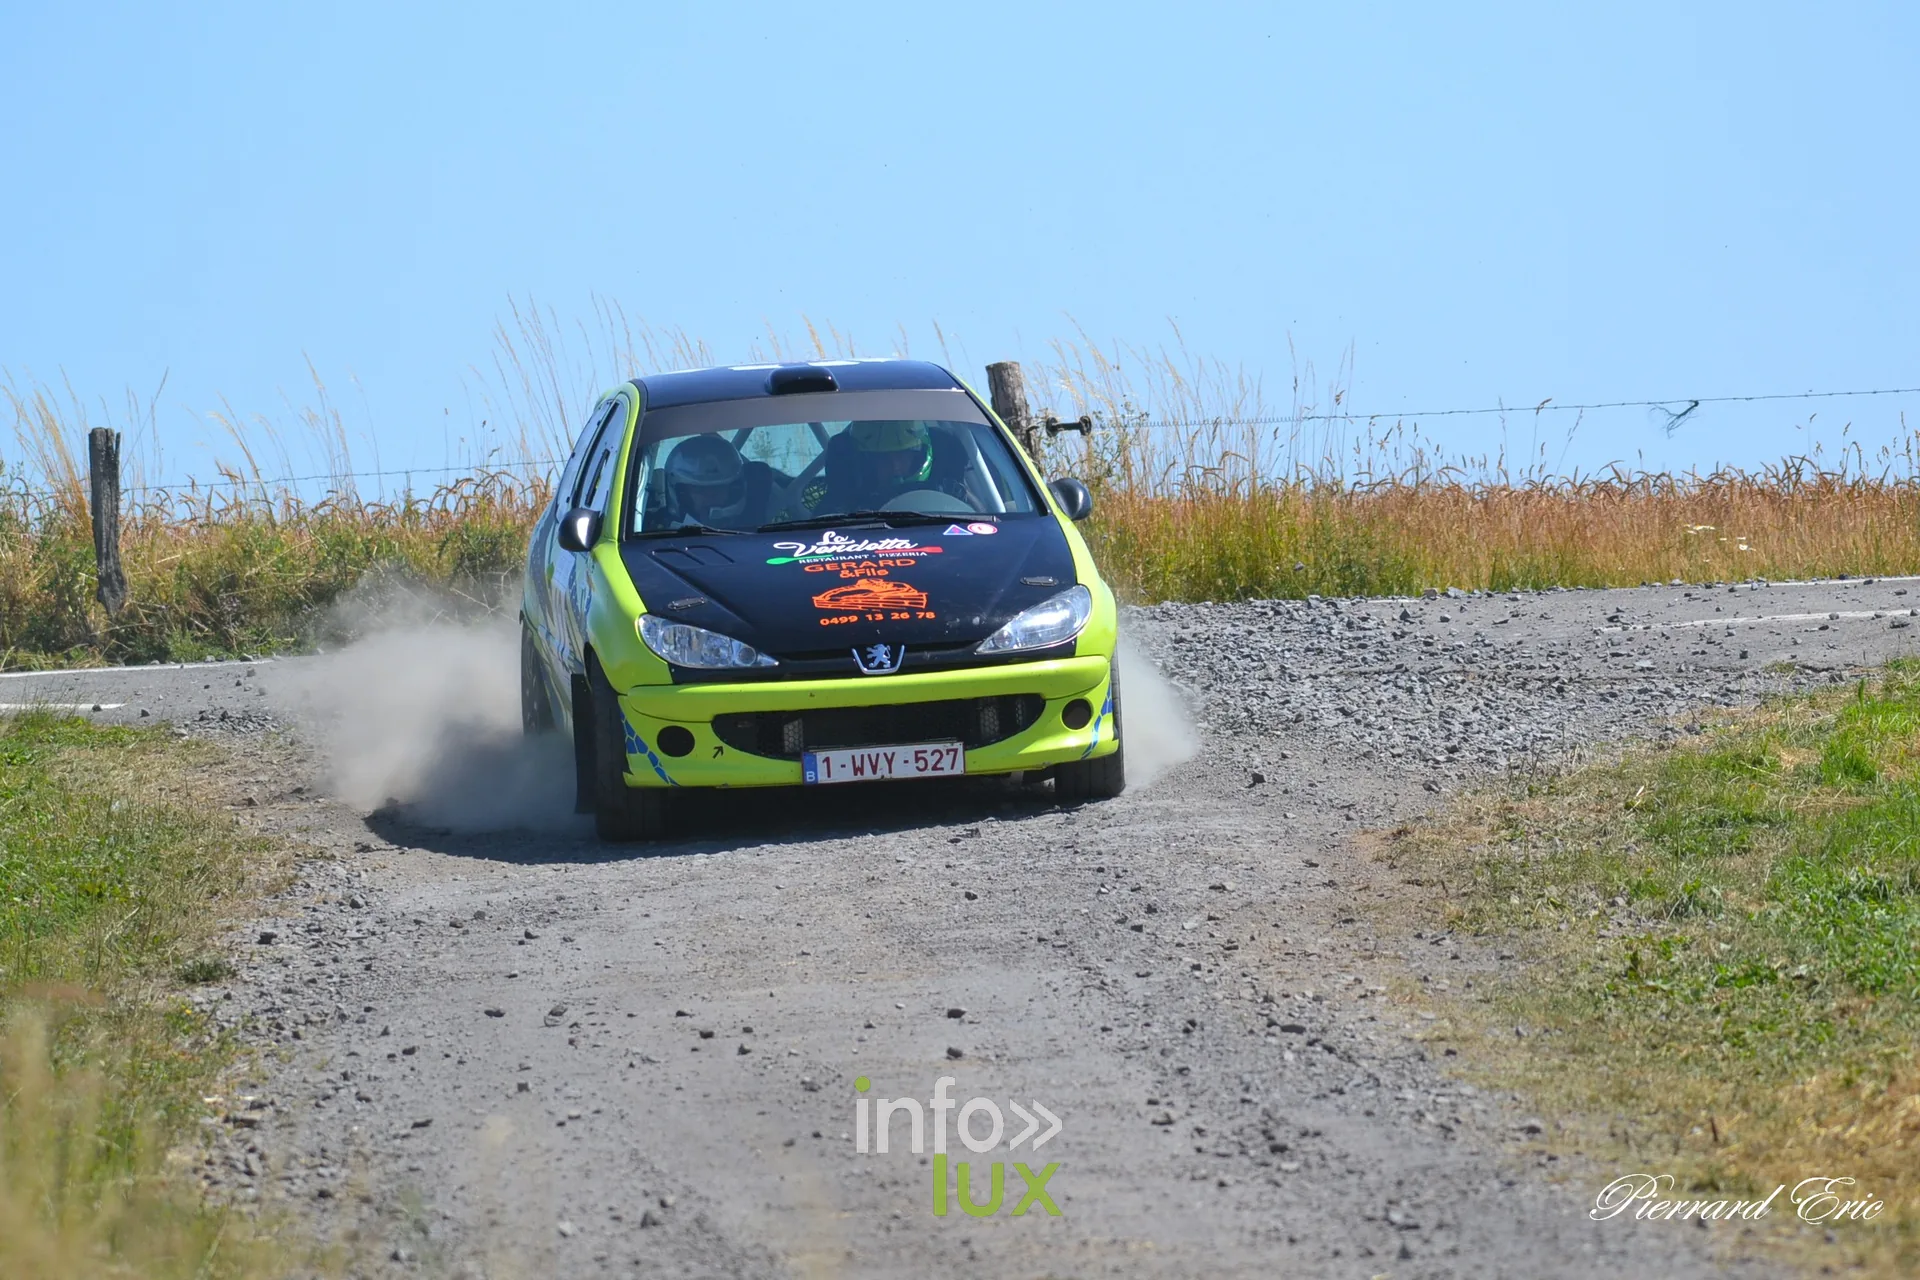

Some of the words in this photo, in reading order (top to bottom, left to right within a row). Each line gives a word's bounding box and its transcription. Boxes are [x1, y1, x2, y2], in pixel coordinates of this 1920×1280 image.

[816, 531, 855, 546] La
[799, 554, 869, 564] RESTAURANT
[804, 558, 916, 572] GERARD
[820, 615, 858, 626] 0499
[865, 613, 884, 621] 13
[890, 612, 910, 620] 26
[916, 611, 936, 619] 78
[806, 771, 816, 782] B
[822, 748, 959, 778] 1-WVY-527
